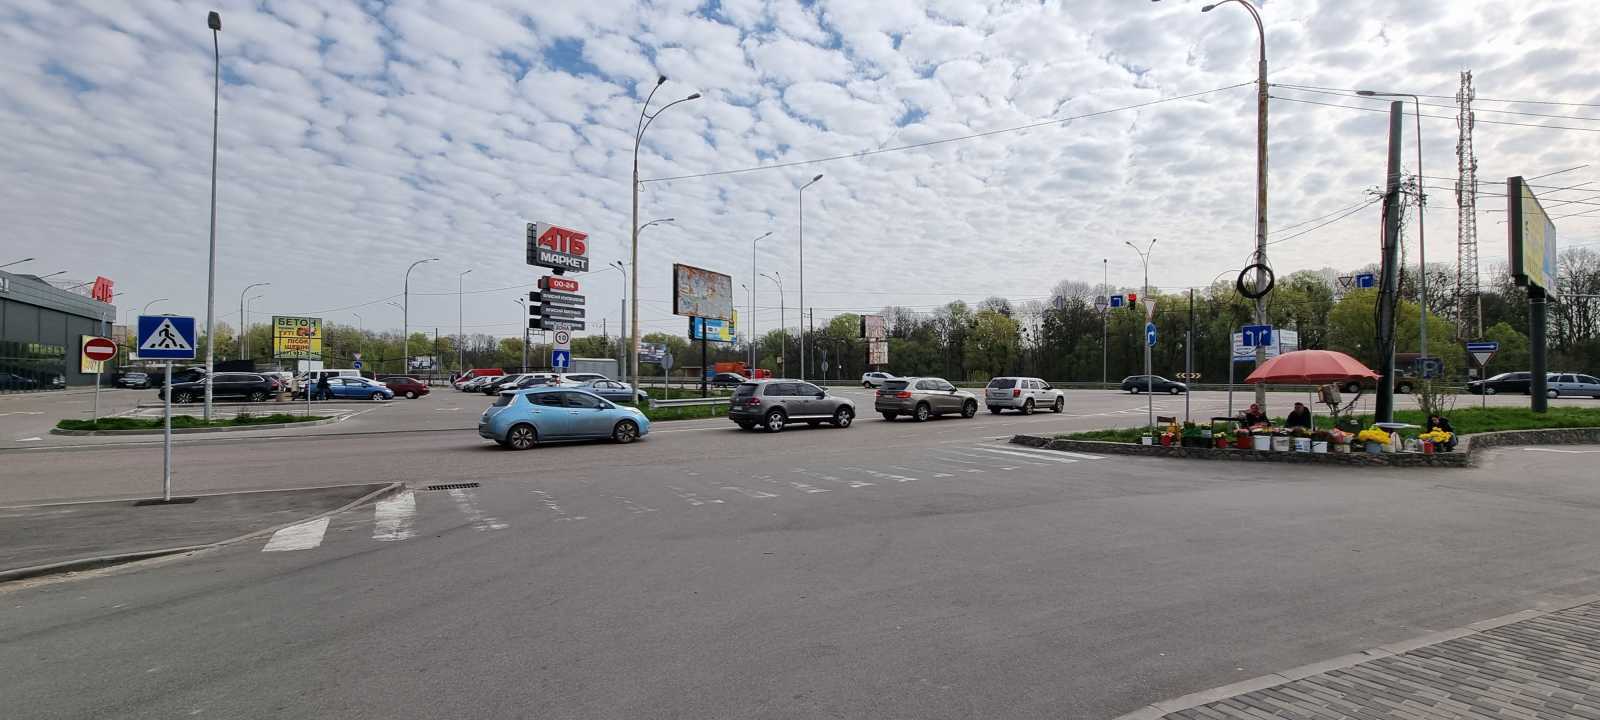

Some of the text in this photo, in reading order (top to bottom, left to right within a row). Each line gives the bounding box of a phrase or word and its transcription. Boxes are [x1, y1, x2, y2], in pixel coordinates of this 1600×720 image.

[538, 226, 588, 255] АТБ
[541, 252, 586, 269] МАРКЕТ
[554, 281, 575, 289] 00-24
